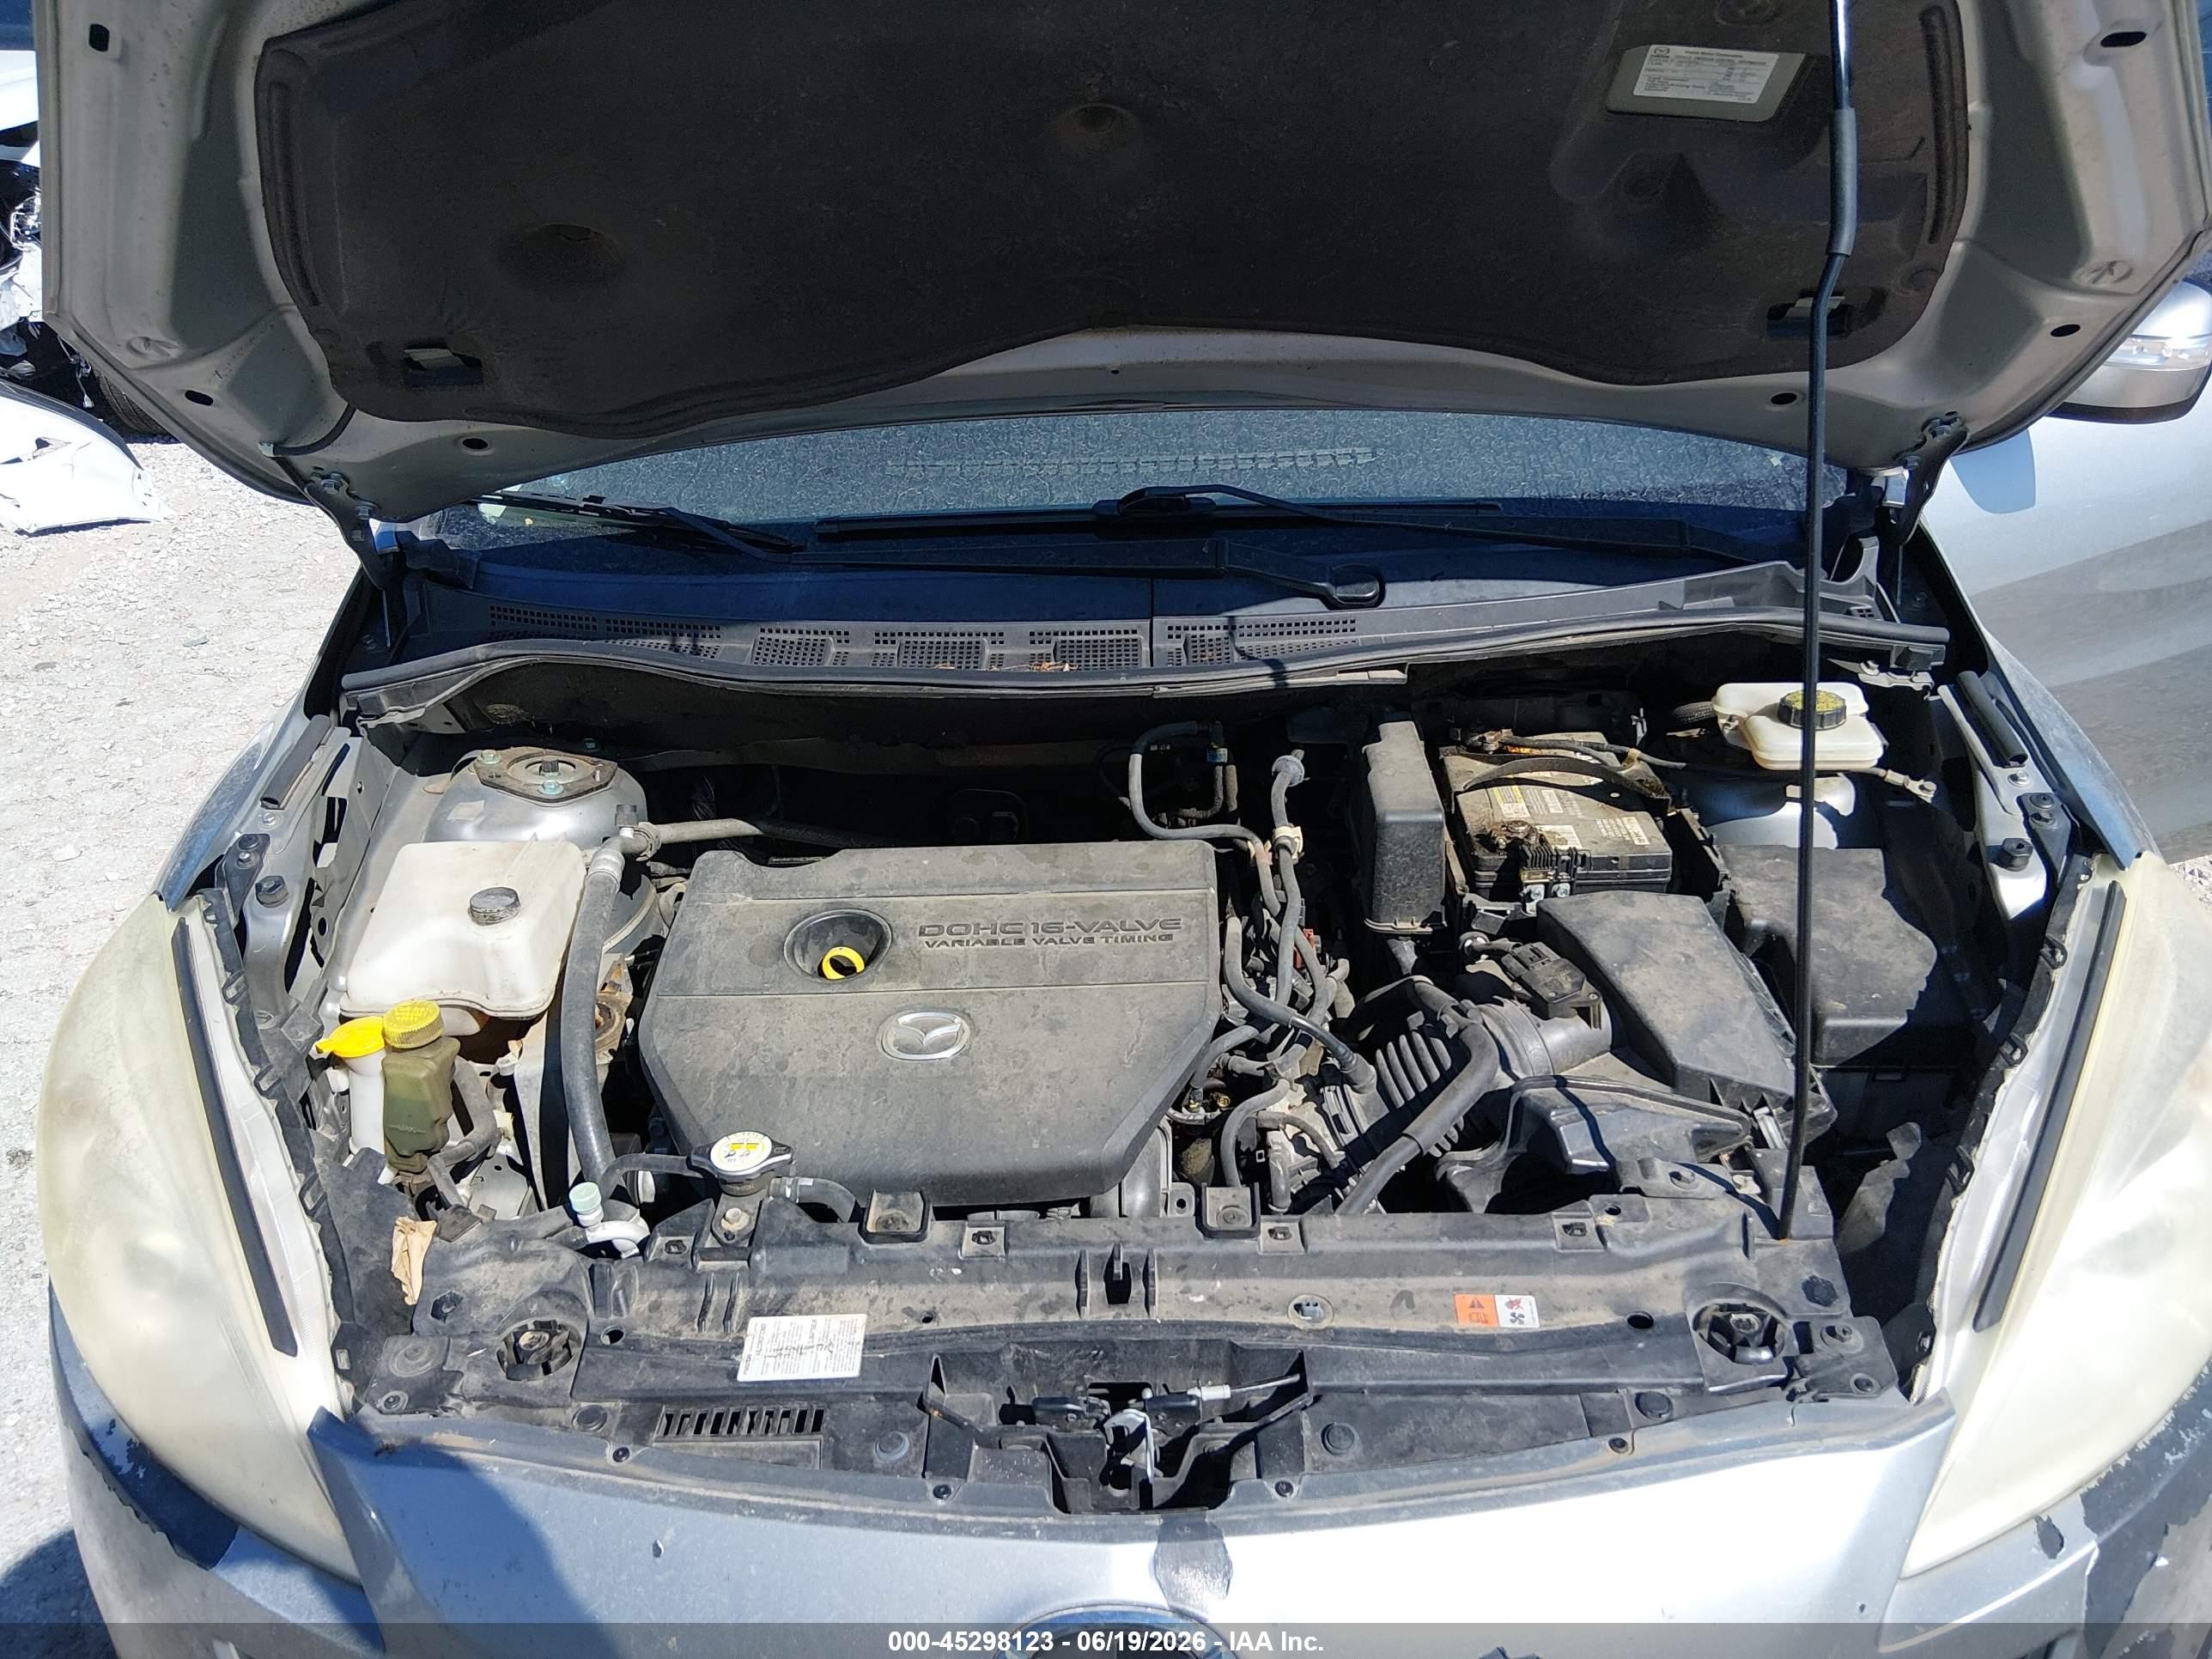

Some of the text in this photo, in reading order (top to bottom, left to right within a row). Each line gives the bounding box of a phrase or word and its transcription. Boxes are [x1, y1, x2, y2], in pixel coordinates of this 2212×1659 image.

[918, 917, 1182, 938] DOHC 16-VALVE
[924, 933, 1174, 949] VARIABLE VALVE TIMING
